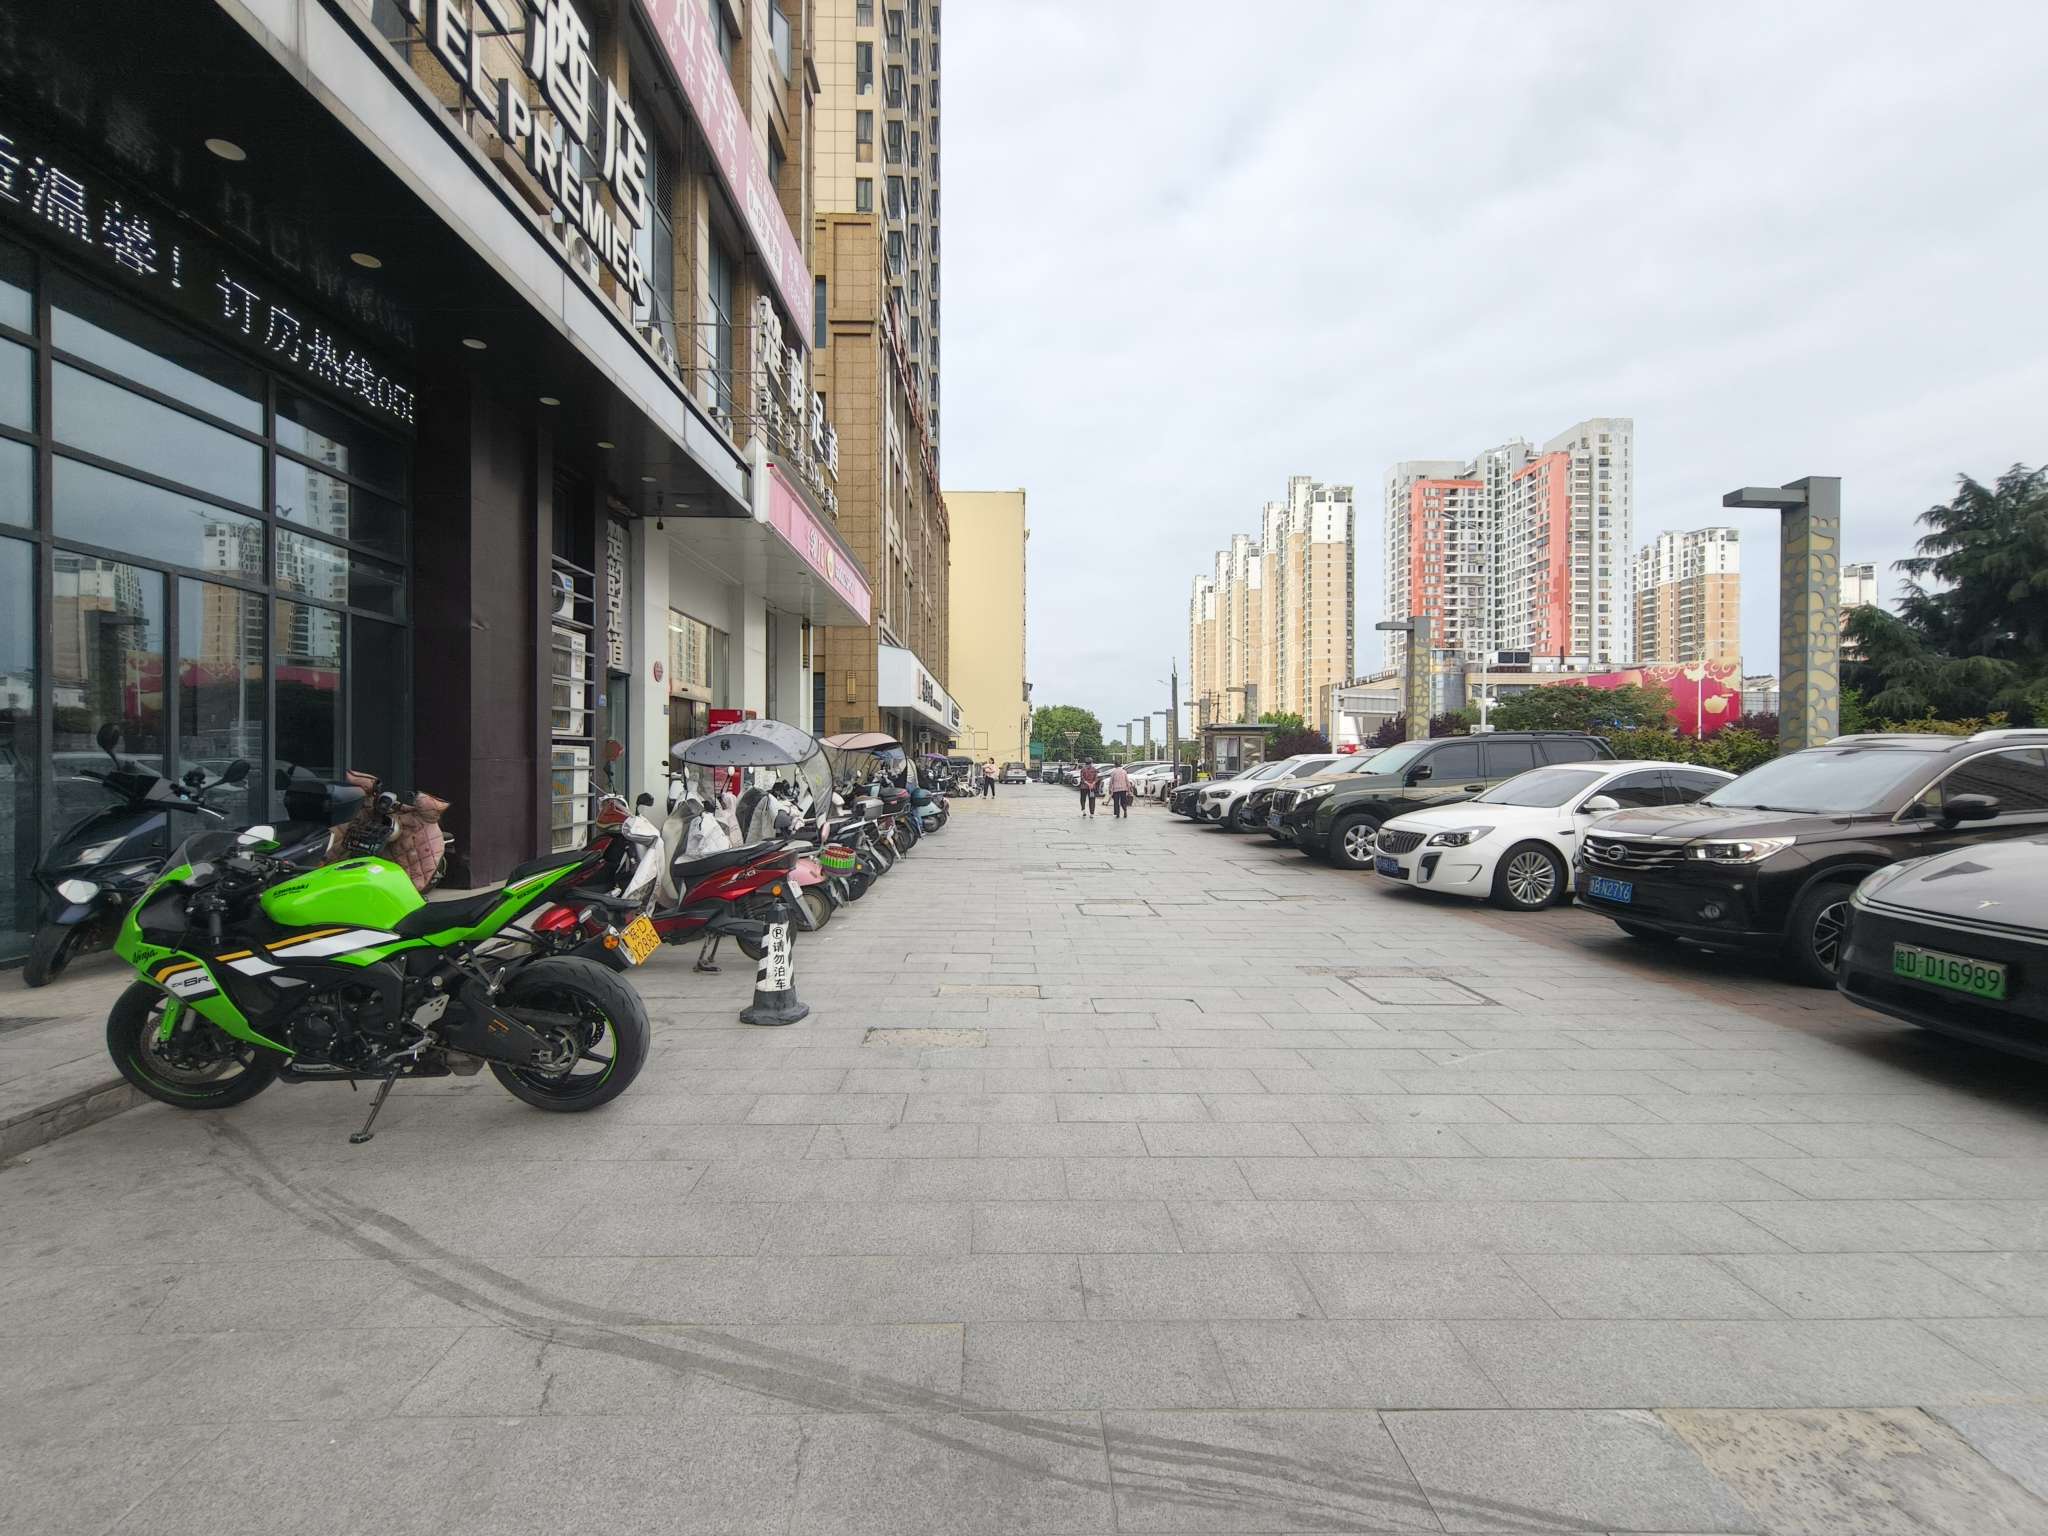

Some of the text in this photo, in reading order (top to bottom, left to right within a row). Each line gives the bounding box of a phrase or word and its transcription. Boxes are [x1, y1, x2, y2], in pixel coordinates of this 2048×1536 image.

[499, 79, 646, 306] PREMIER
[132, 949, 158, 964] Ninja
[773, 940, 786, 990] 请勿泊车
